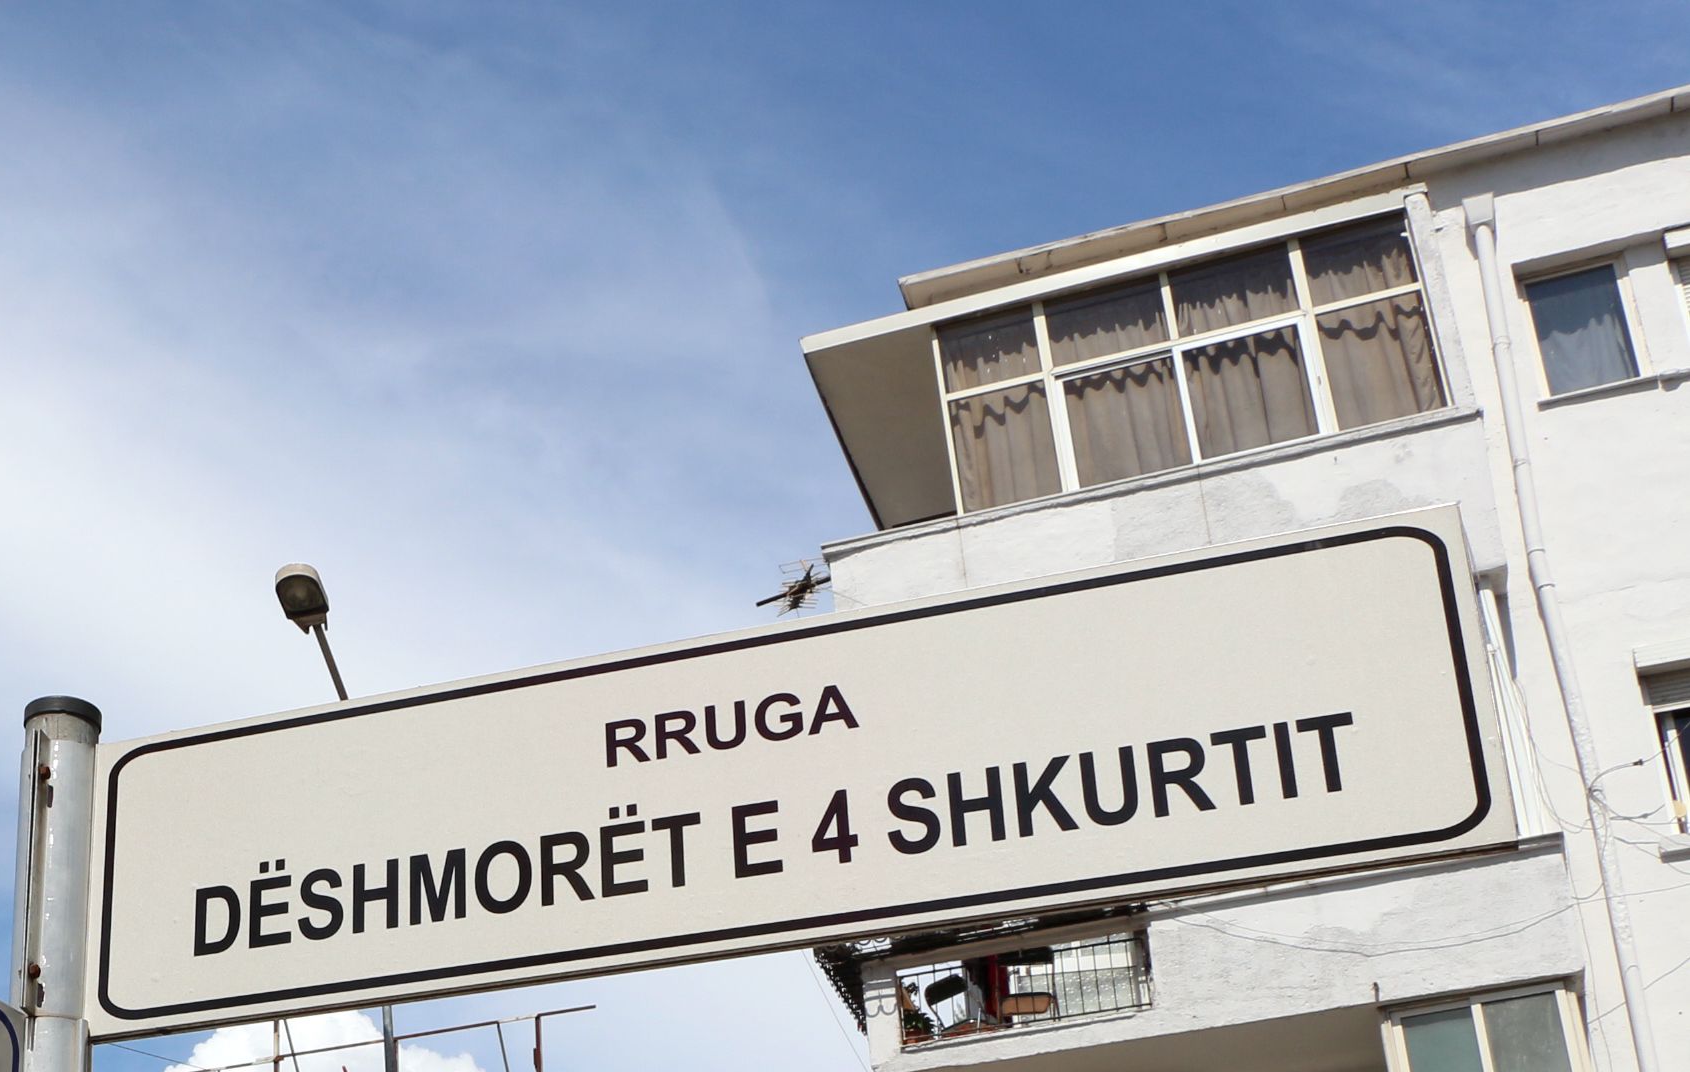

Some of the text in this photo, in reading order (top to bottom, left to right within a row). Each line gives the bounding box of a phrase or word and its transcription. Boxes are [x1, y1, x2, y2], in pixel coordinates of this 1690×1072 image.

[606, 686, 858, 767] RRUGA
[192, 712, 1354, 958] DËSHMORËT E 4 SHKURTIT
